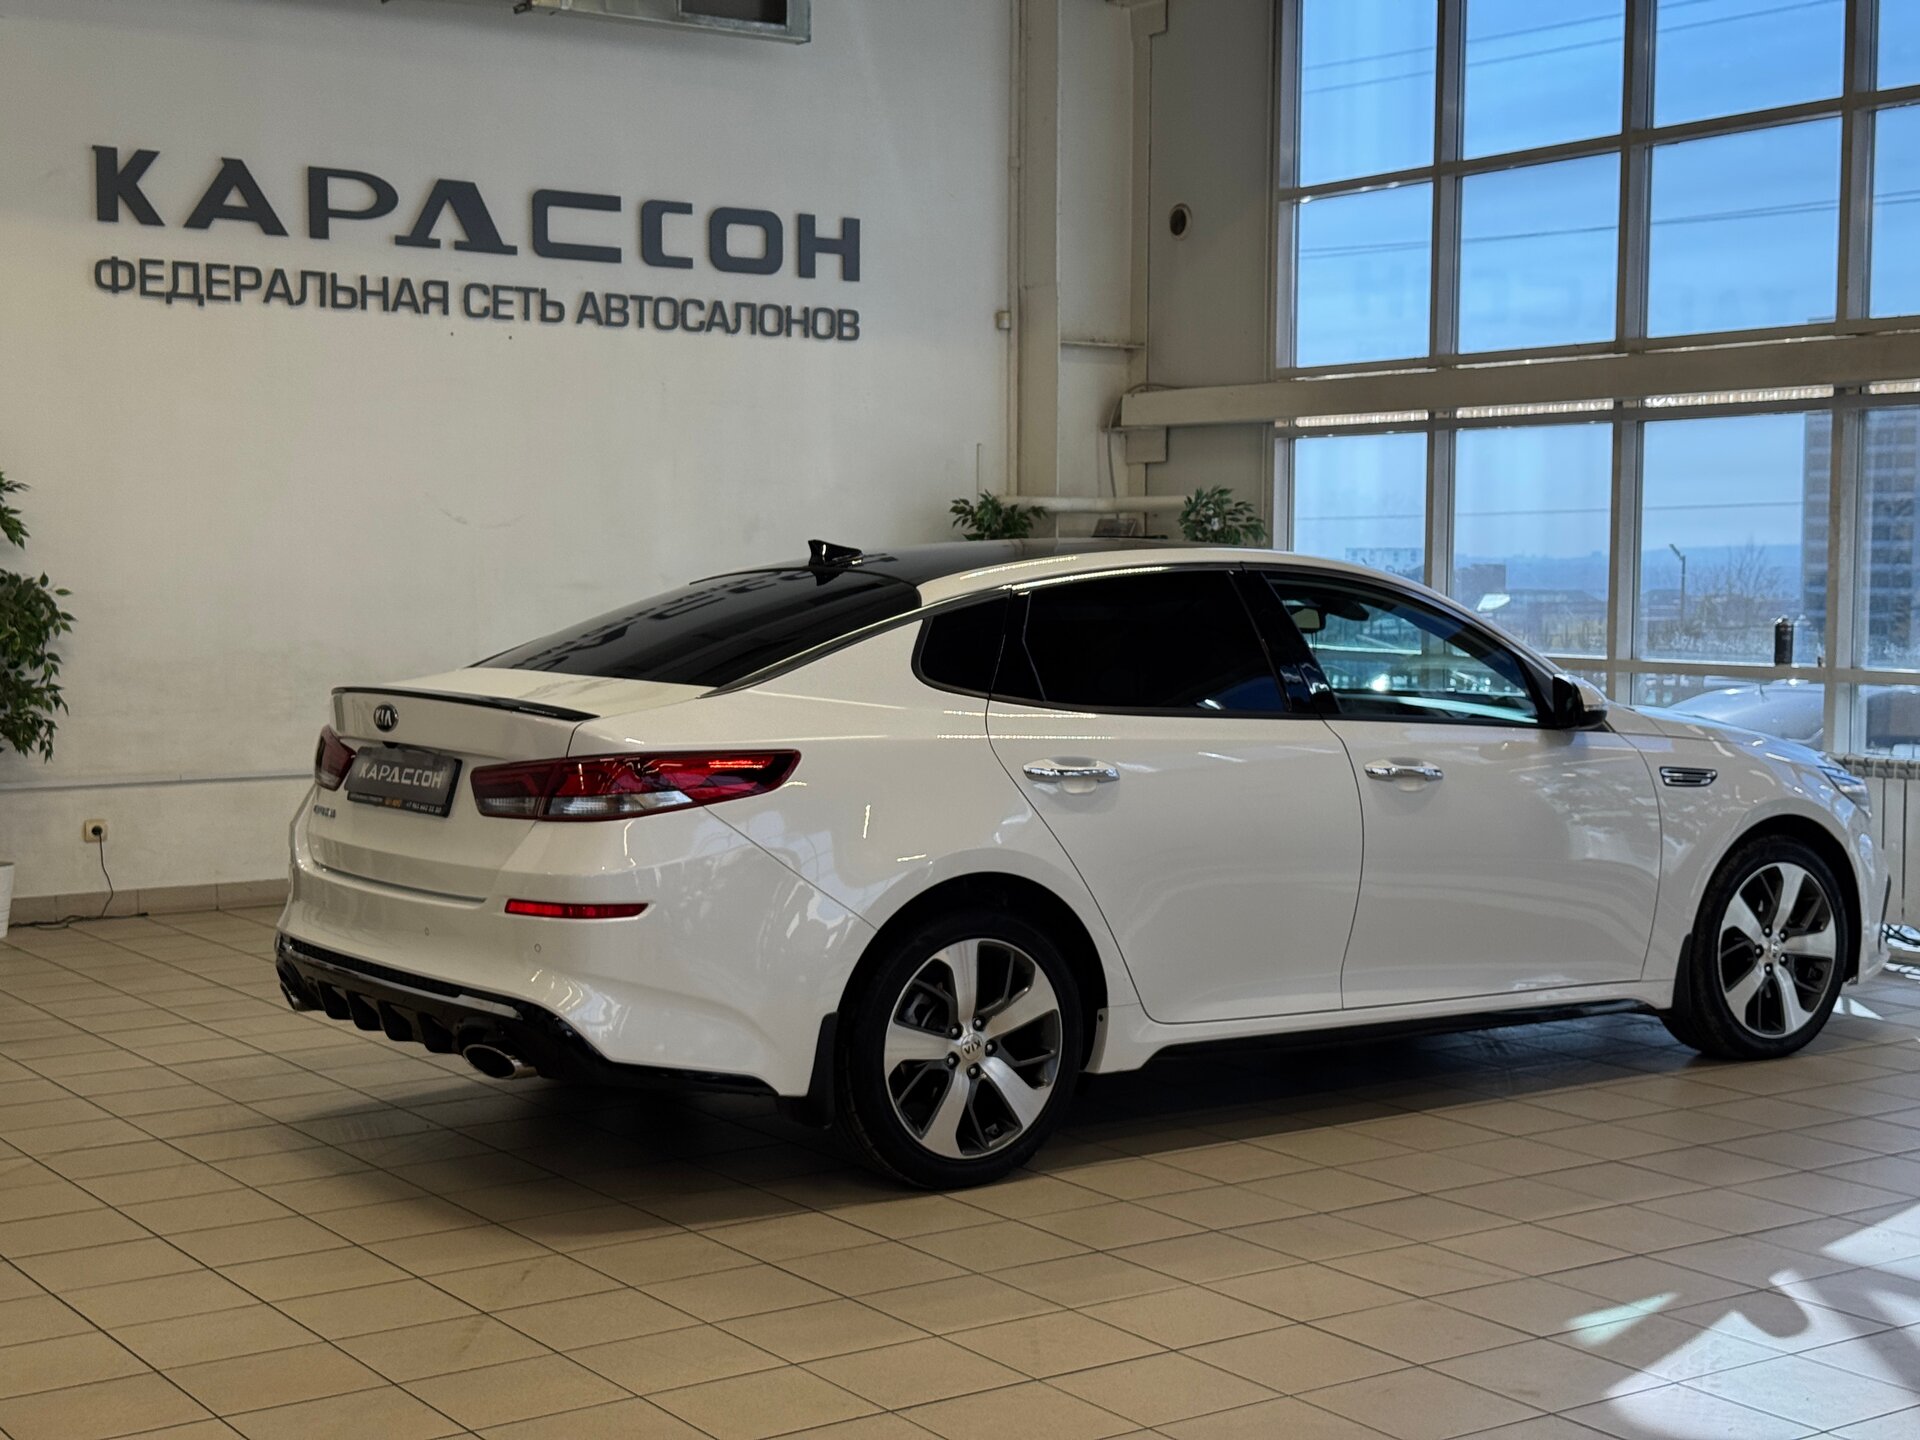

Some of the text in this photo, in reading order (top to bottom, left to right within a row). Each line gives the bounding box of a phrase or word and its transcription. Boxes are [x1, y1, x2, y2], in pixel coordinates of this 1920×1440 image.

[94, 256, 860, 341] ФЕДЕРАЛЬНАЯ СЕТЬ АВТОСАЛОНОВ
[375, 709, 393, 726] KIA
[964, 1040, 982, 1055] KIA
